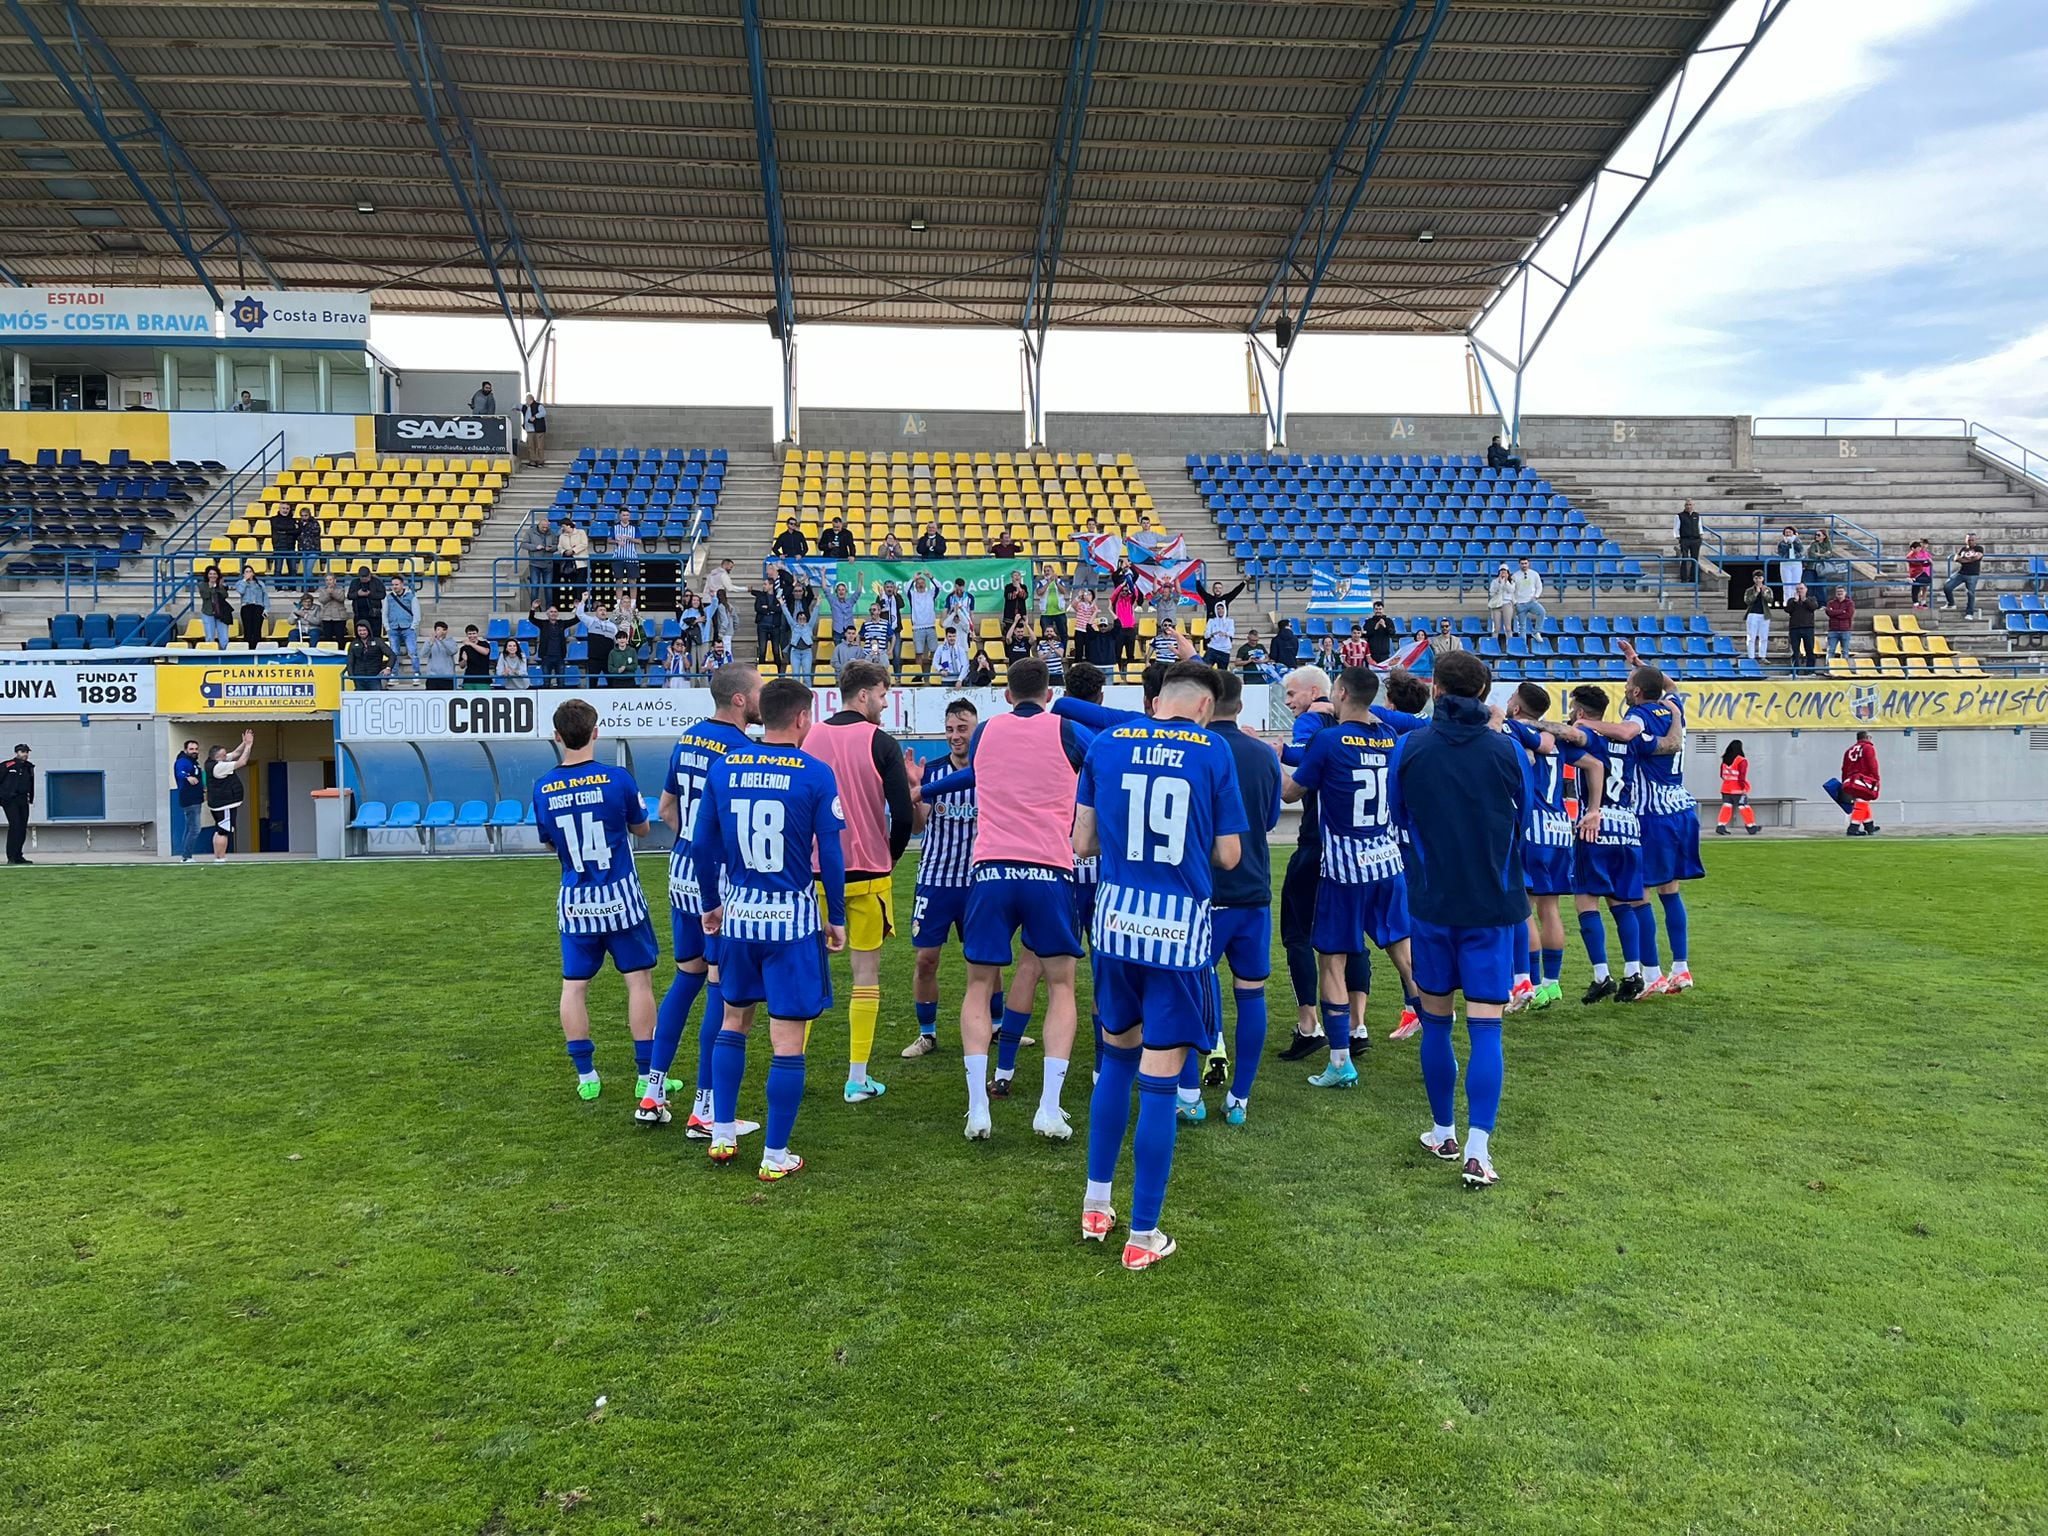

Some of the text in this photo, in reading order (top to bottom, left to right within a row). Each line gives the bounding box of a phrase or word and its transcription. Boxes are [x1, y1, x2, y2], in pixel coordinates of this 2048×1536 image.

[47, 293, 105, 304] ESTADI
[64, 313, 130, 330] COSTA
[137, 314, 209, 331] BRAVA
[273, 309, 367, 323] Costa Brava
[396, 420, 485, 440] SAAB
[76, 672, 138, 683] FUNDAT
[223, 669, 315, 678] PLANXISTERIA
[77, 685, 138, 704] 1898
[227, 685, 254, 696] SANT
[256, 685, 293, 696] ANTONI
[1883, 689, 1949, 718] ANYS
[342, 697, 534, 735] TECNOCARD
[599, 714, 631, 727] ADÍS
[637, 716, 653, 727] DE
[1112, 728, 1148, 738] CAJA
[1341, 735, 1367, 747] CAJA
[725, 753, 754, 765] CAJA
[1131, 743, 1185, 768] A. LÓPEZ
[541, 780, 567, 794] CAJA
[740, 772, 791, 791] ABELENDA
[1545, 756, 1557, 804] 7
[1606, 756, 1625, 803] 8
[548, 786, 604, 811] JOSEP CERDÀ
[1121, 772, 1191, 867] 19
[555, 811, 612, 873] 14
[730, 798, 785, 873] 18
[576, 903, 624, 915] VALCARCE
[736, 908, 792, 920] VALCARCE
[1120, 920, 1186, 941] VALCARCE
